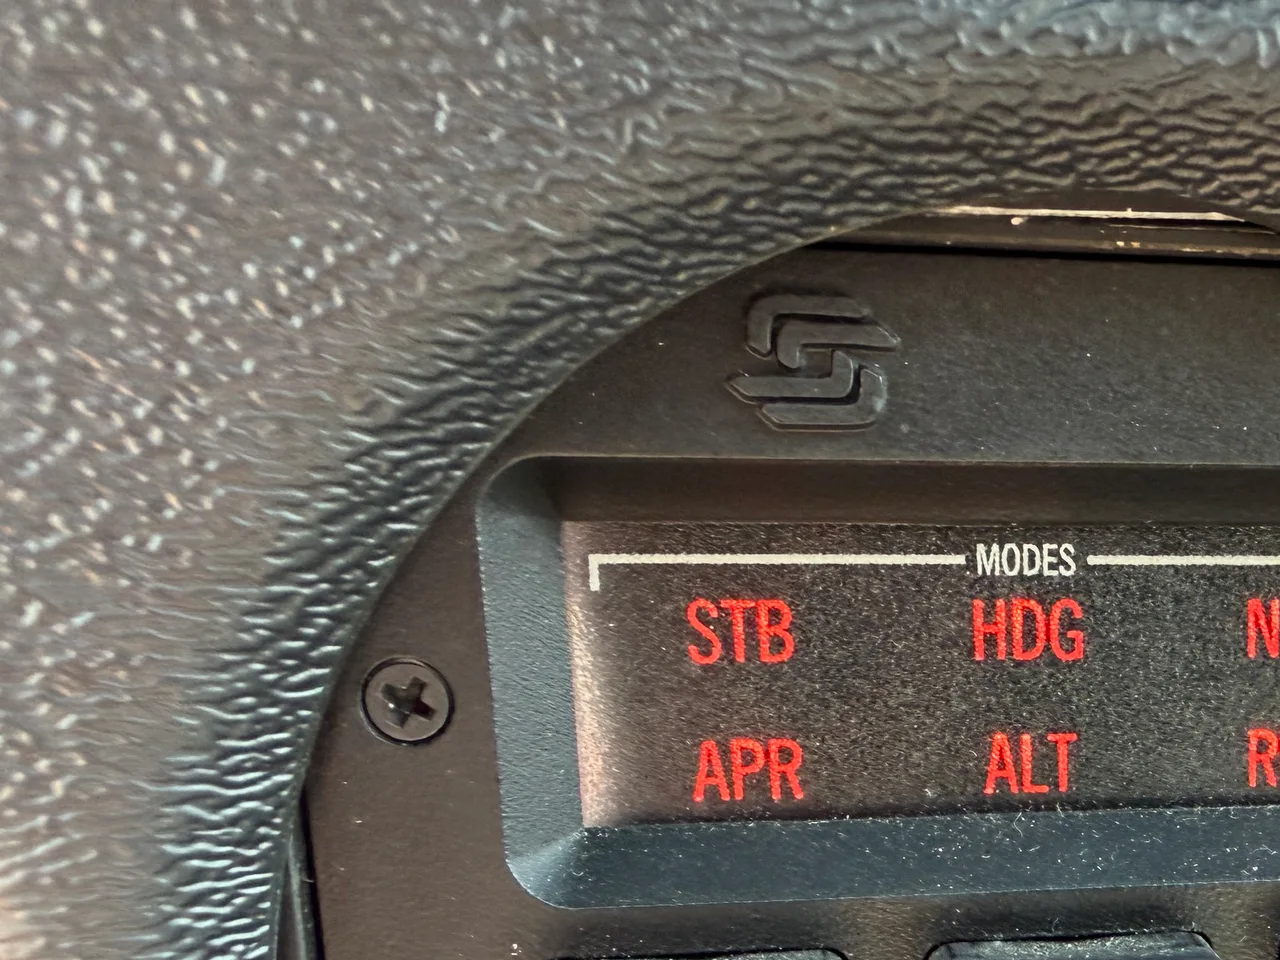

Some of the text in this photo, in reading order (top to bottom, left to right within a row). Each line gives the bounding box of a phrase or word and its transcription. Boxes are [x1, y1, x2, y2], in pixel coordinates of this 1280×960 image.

[977, 543, 1077, 577] MODES
[687, 599, 796, 665] STB
[973, 599, 1087, 662] HDG
[693, 737, 804, 801] APR
[985, 732, 1078, 795] ALT
